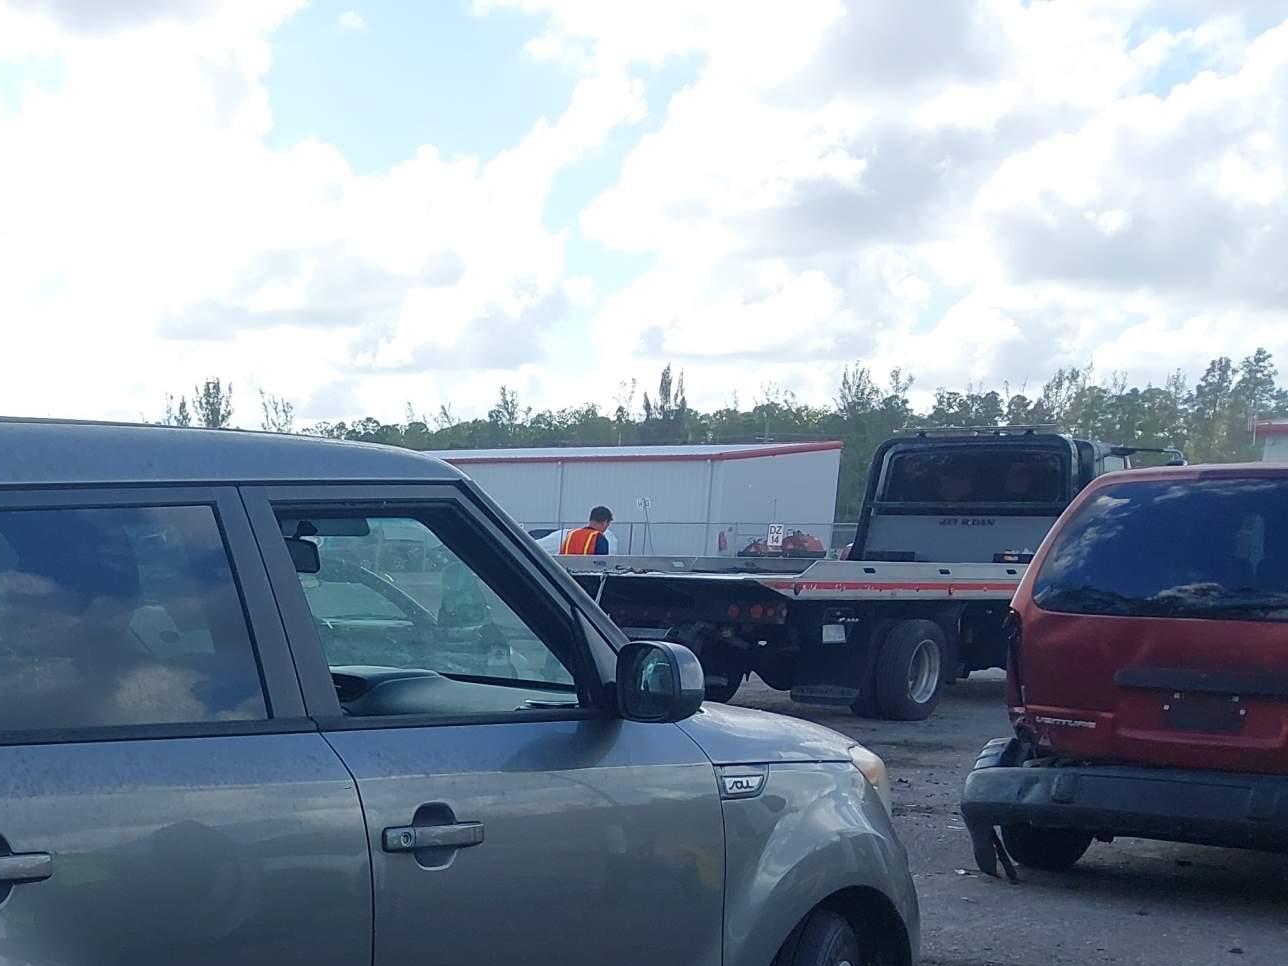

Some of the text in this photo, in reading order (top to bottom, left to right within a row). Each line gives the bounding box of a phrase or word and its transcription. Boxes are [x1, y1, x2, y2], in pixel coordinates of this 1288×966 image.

[769, 525, 783, 535] DZ
[771, 535, 780, 545] 14
[728, 779, 755, 791] SOUL
